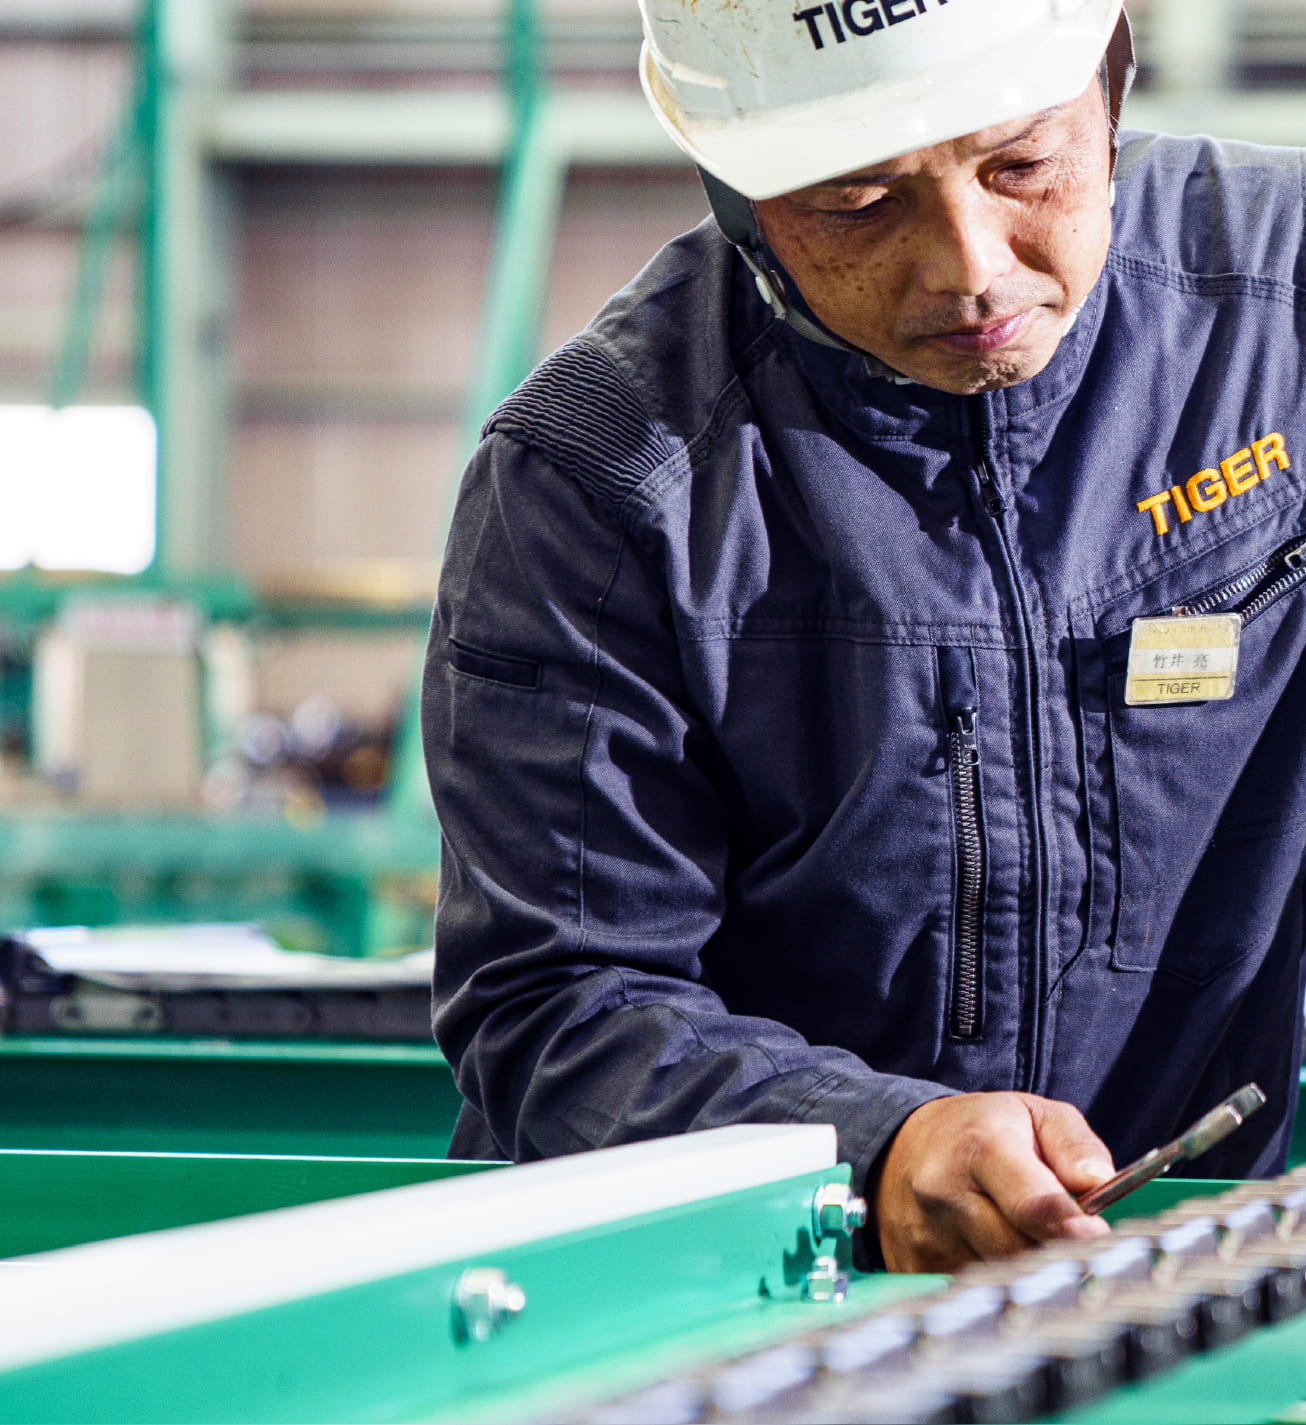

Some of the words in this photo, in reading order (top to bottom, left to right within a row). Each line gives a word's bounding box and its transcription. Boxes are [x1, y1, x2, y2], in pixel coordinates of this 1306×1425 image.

[1136, 432, 1291, 535] TIGER
[1152, 653, 1185, 669] 竹井
[1157, 682, 1201, 695] TIGER
